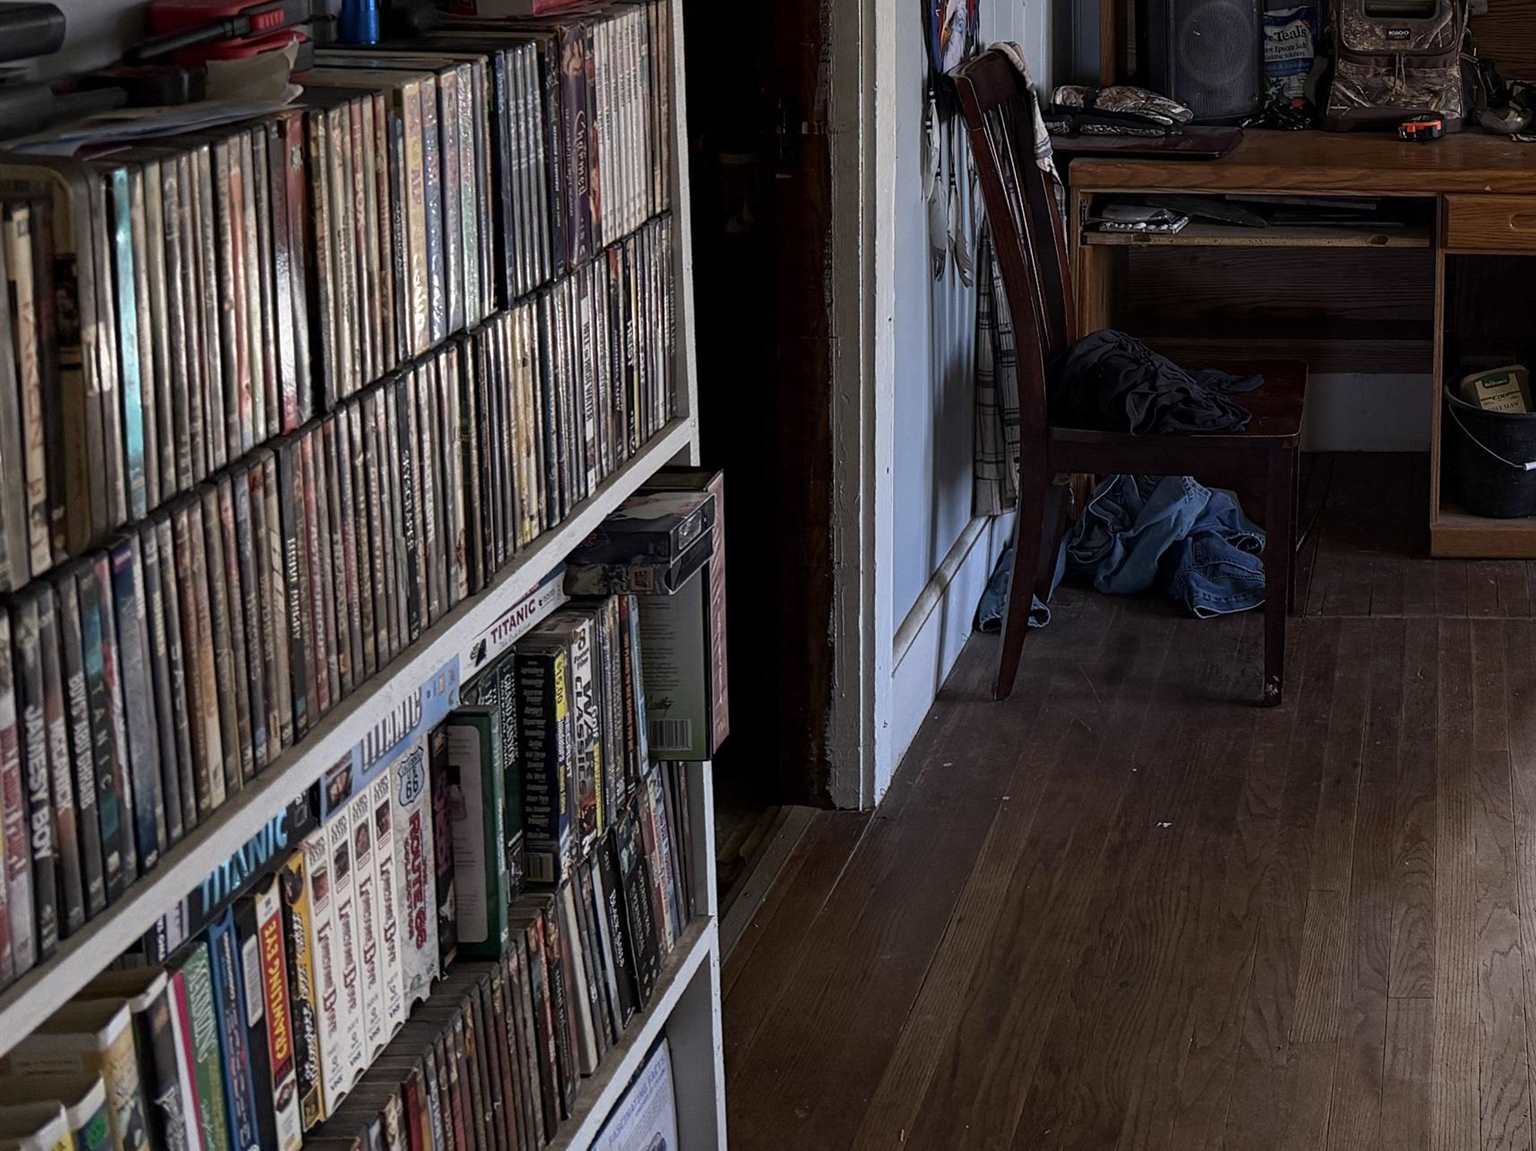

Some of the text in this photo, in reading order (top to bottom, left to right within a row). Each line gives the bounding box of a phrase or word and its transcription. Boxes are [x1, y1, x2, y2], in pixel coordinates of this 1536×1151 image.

[1273, 25, 1307, 42] Teal's
[574, 110, 589, 198] Charmed
[402, 449, 415, 552] SKYSCRAPER
[490, 599, 537, 642] TITANIC
[24, 704, 52, 861] JAMESY BOY
[263, 920, 279, 955] EYE
[268, 958, 287, 1060] CRAWLING
